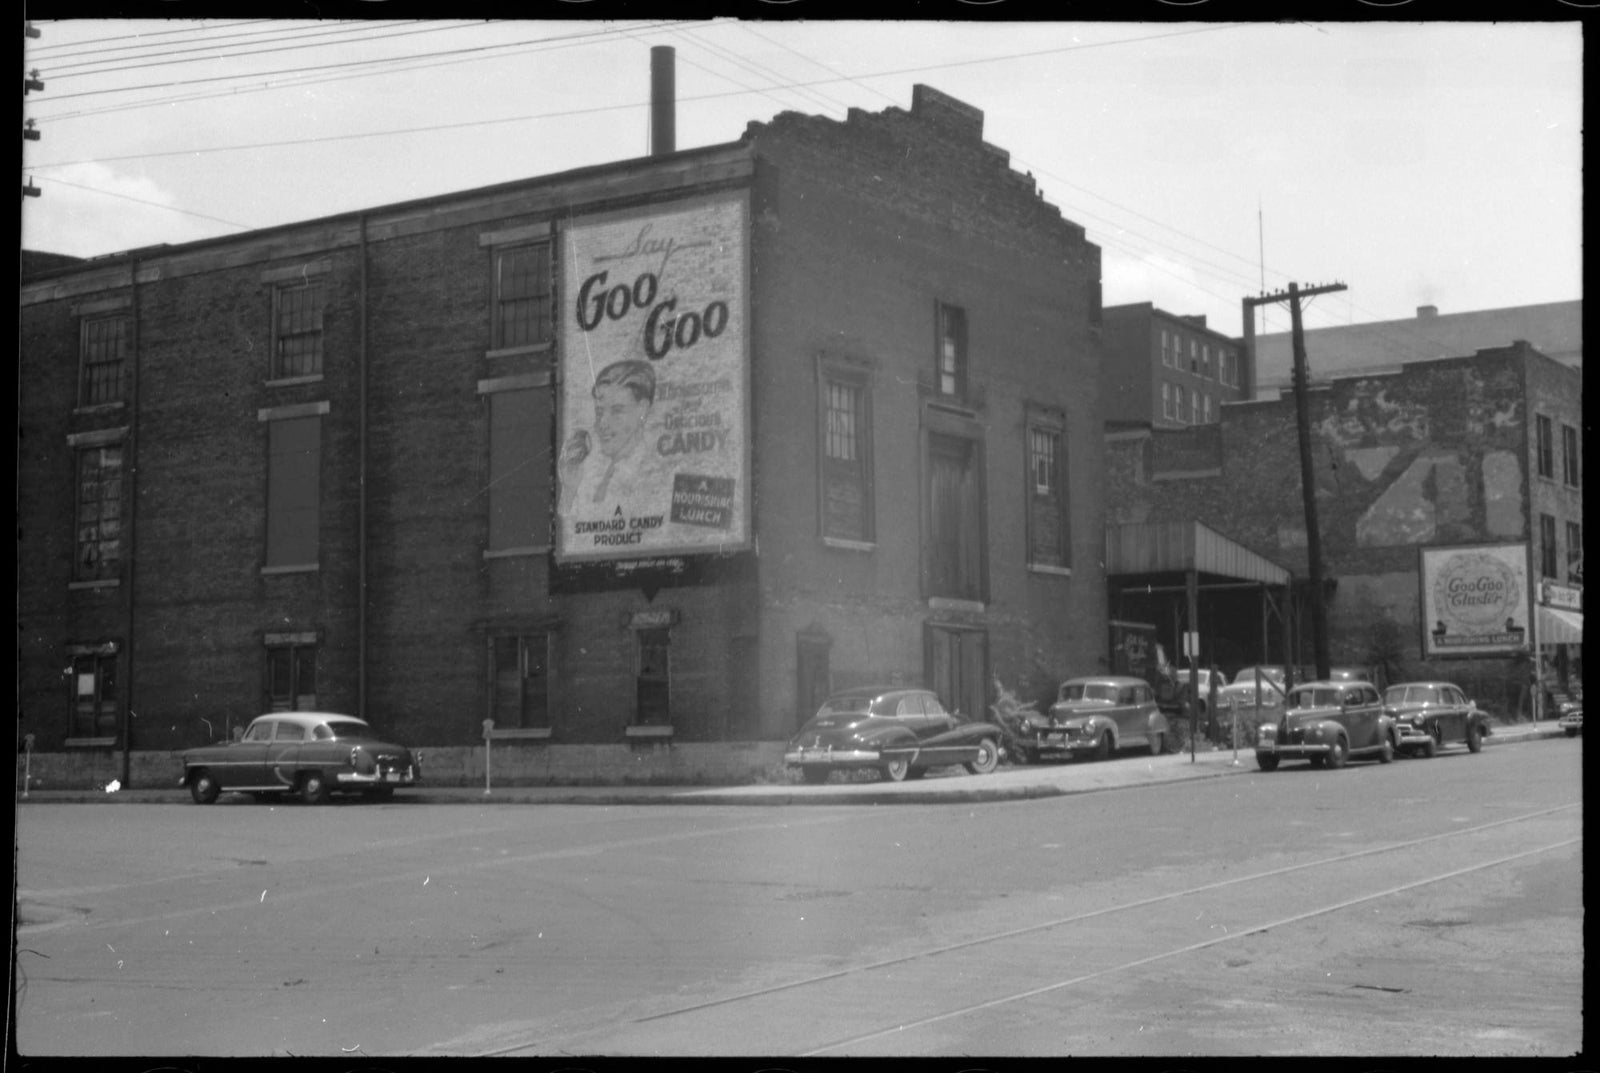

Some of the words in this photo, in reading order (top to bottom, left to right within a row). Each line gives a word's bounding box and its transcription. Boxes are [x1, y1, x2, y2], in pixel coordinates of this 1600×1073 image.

[656, 429, 731, 457] CANDY
[614, 504, 622, 516] A
[679, 507, 722, 523] LUNCH
[575, 518, 625, 534] STANDARD
[629, 515, 664, 530] CANDY
[594, 532, 643, 546] PRODUCT
